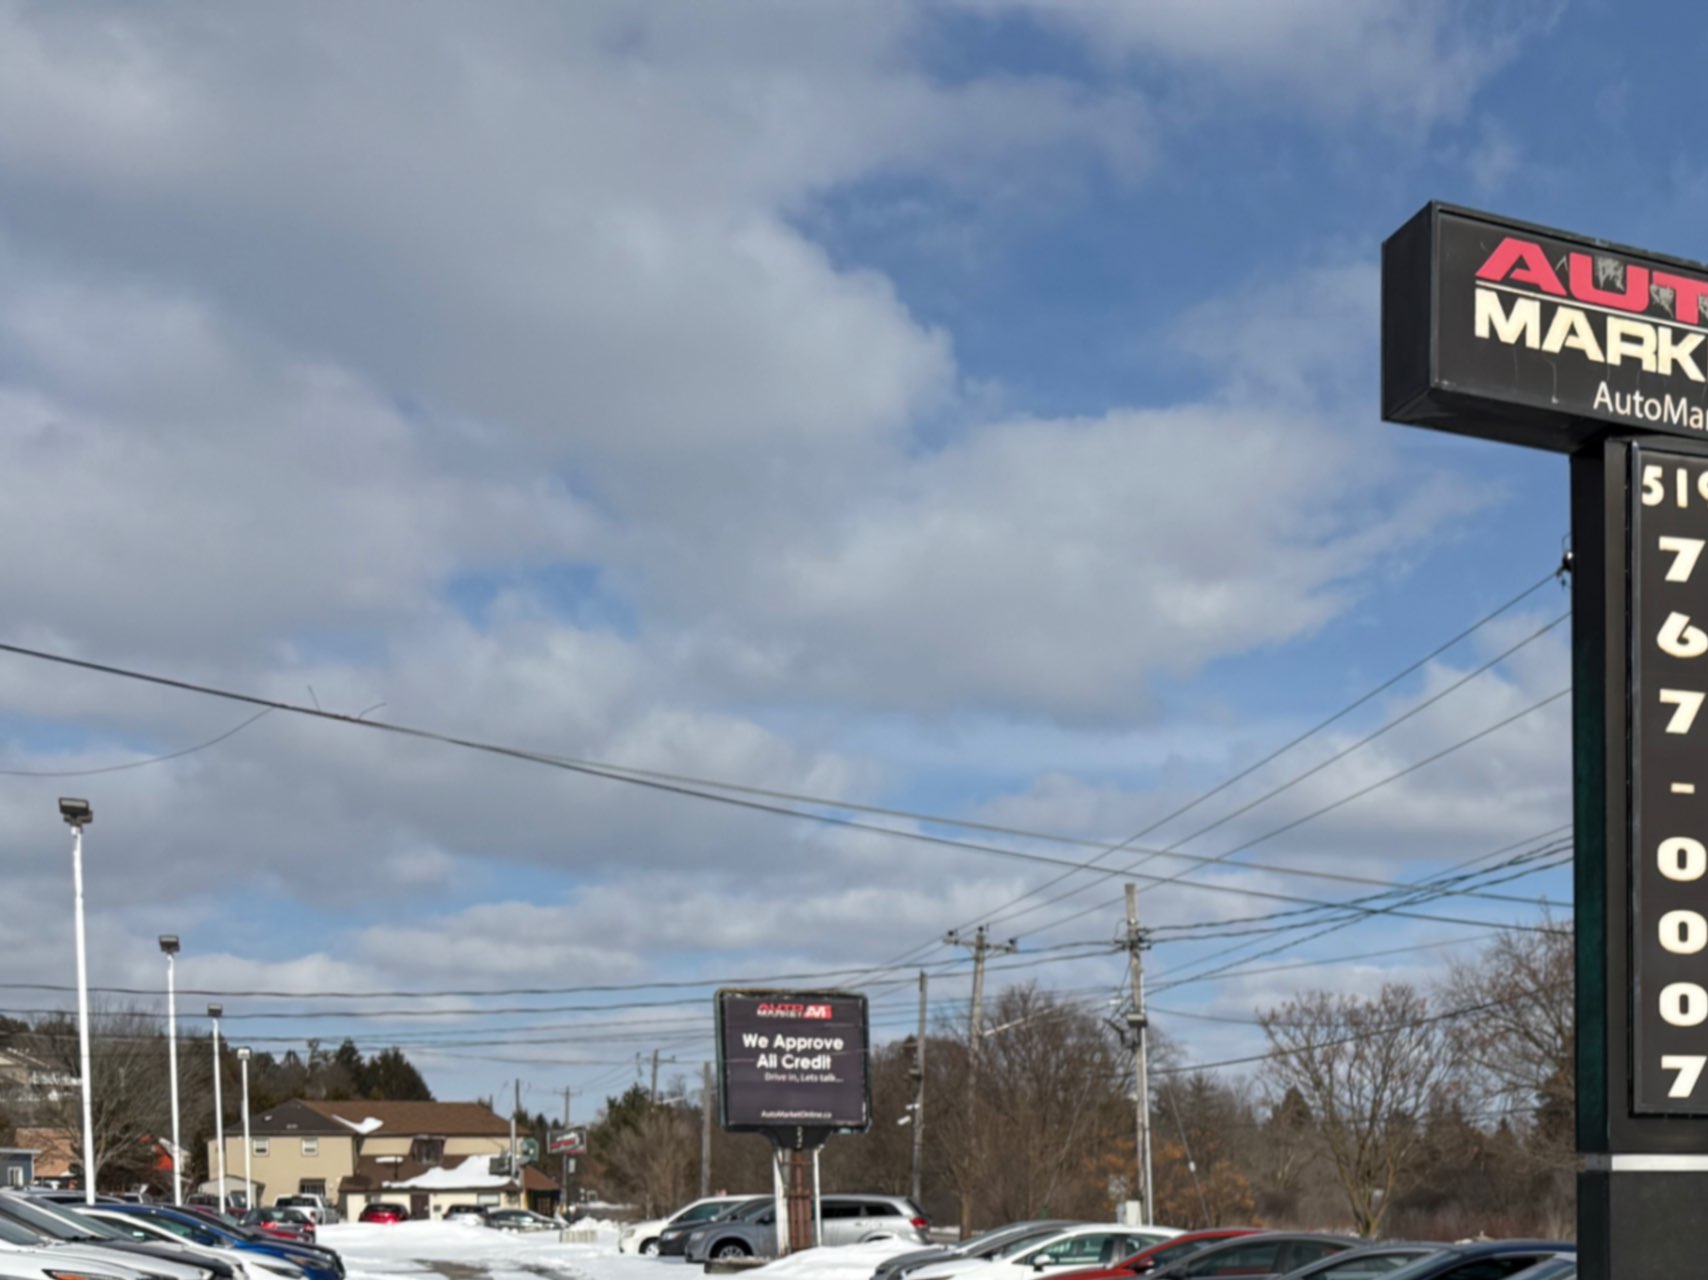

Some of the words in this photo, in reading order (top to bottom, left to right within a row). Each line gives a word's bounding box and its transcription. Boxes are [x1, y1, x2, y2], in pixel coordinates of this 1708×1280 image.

[742, 1033, 769, 1049] We
[773, 1034, 844, 1052] Approve
[757, 1053, 777, 1068] All
[781, 1054, 832, 1070] Credit
